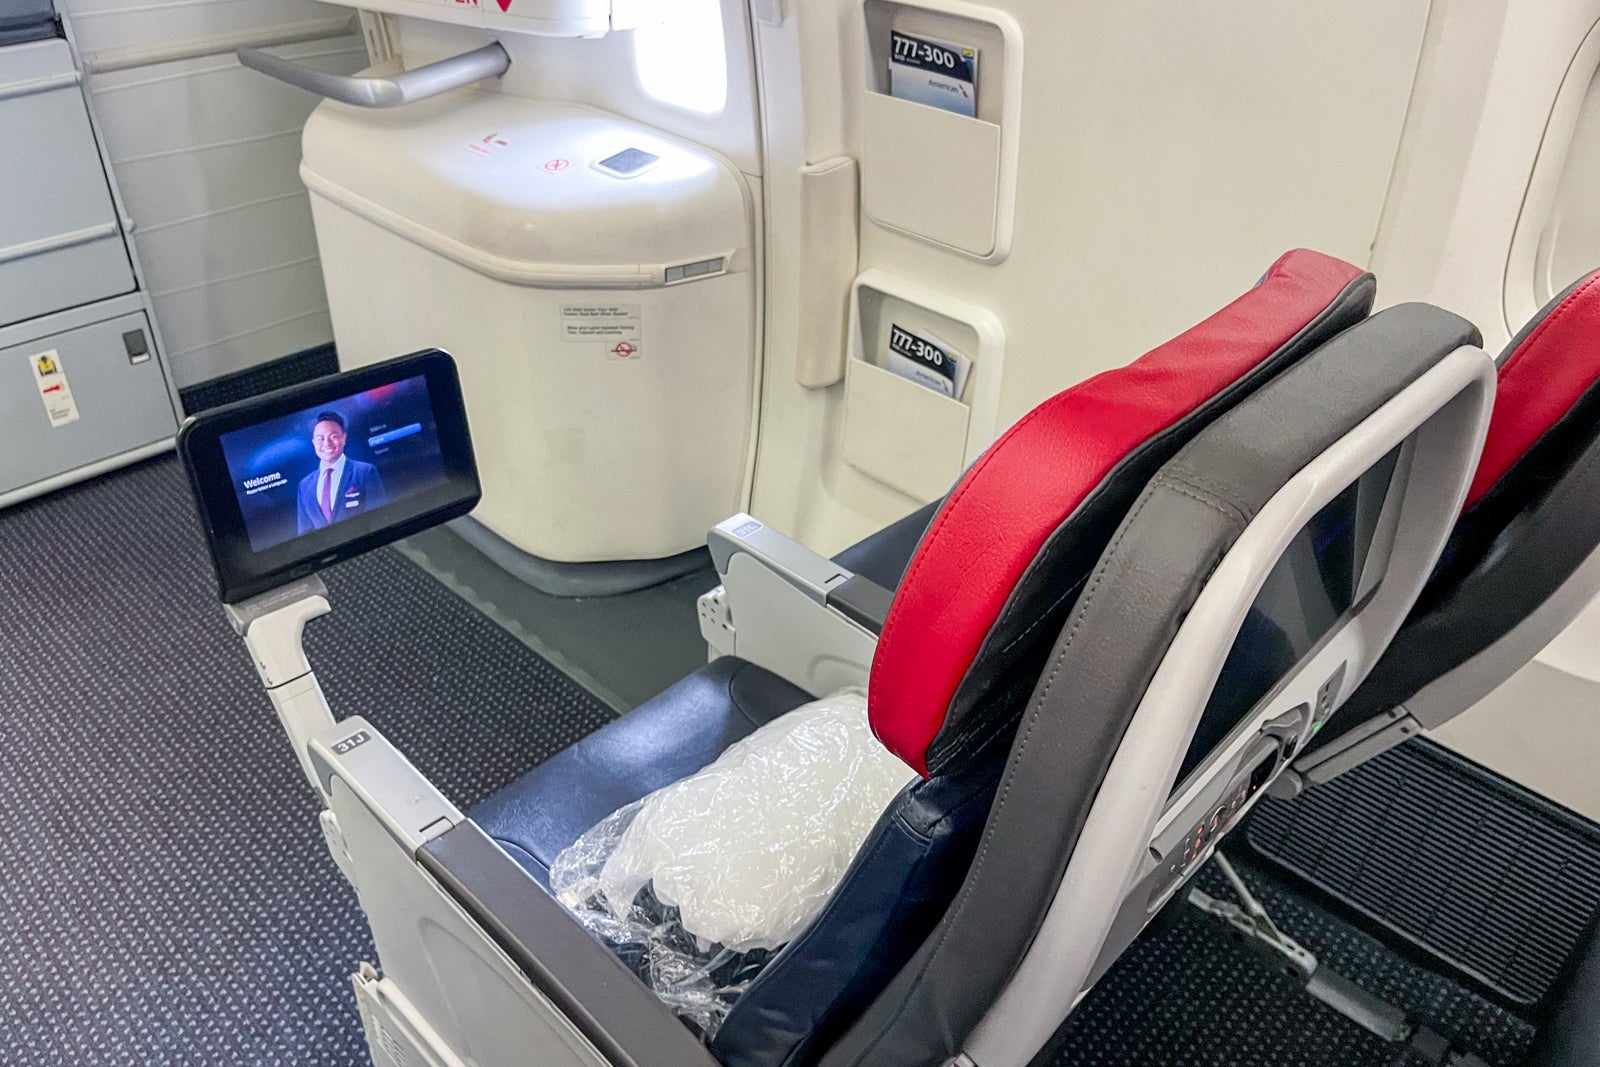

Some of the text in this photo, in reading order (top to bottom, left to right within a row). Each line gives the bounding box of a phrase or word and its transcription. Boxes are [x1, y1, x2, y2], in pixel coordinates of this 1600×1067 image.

[893, 36, 955, 69] 777-300
[927, 77, 960, 93] American
[892, 328, 943, 366] 777-300
[243, 472, 281, 489] Welcome
[337, 734, 365, 752] 31J
